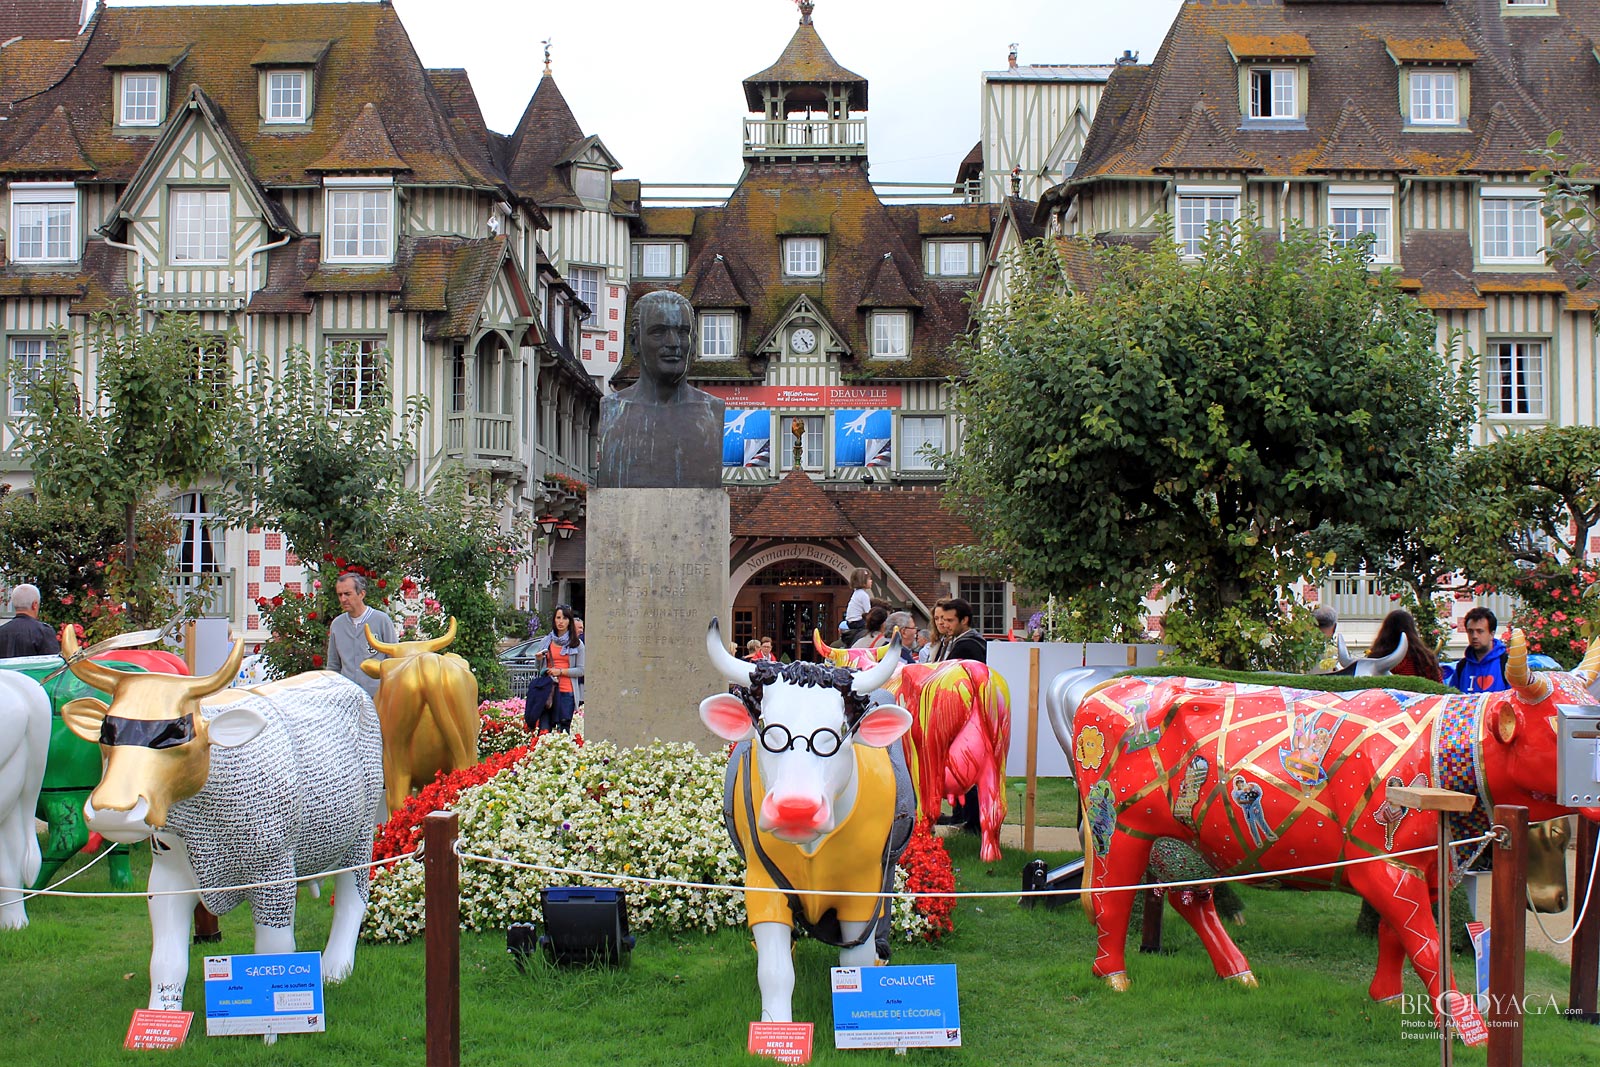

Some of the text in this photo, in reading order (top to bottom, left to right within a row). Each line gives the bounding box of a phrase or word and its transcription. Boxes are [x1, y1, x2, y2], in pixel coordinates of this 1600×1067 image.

[746, 545, 848, 572] Normandy Barrière
[1467, 676, 1476, 691] I
[245, 964, 311, 977] SACRED COW
[879, 975, 936, 987] COWLUCHE
[852, 1008, 941, 1018] MATHILDE DE L'ÉCOTAIS
